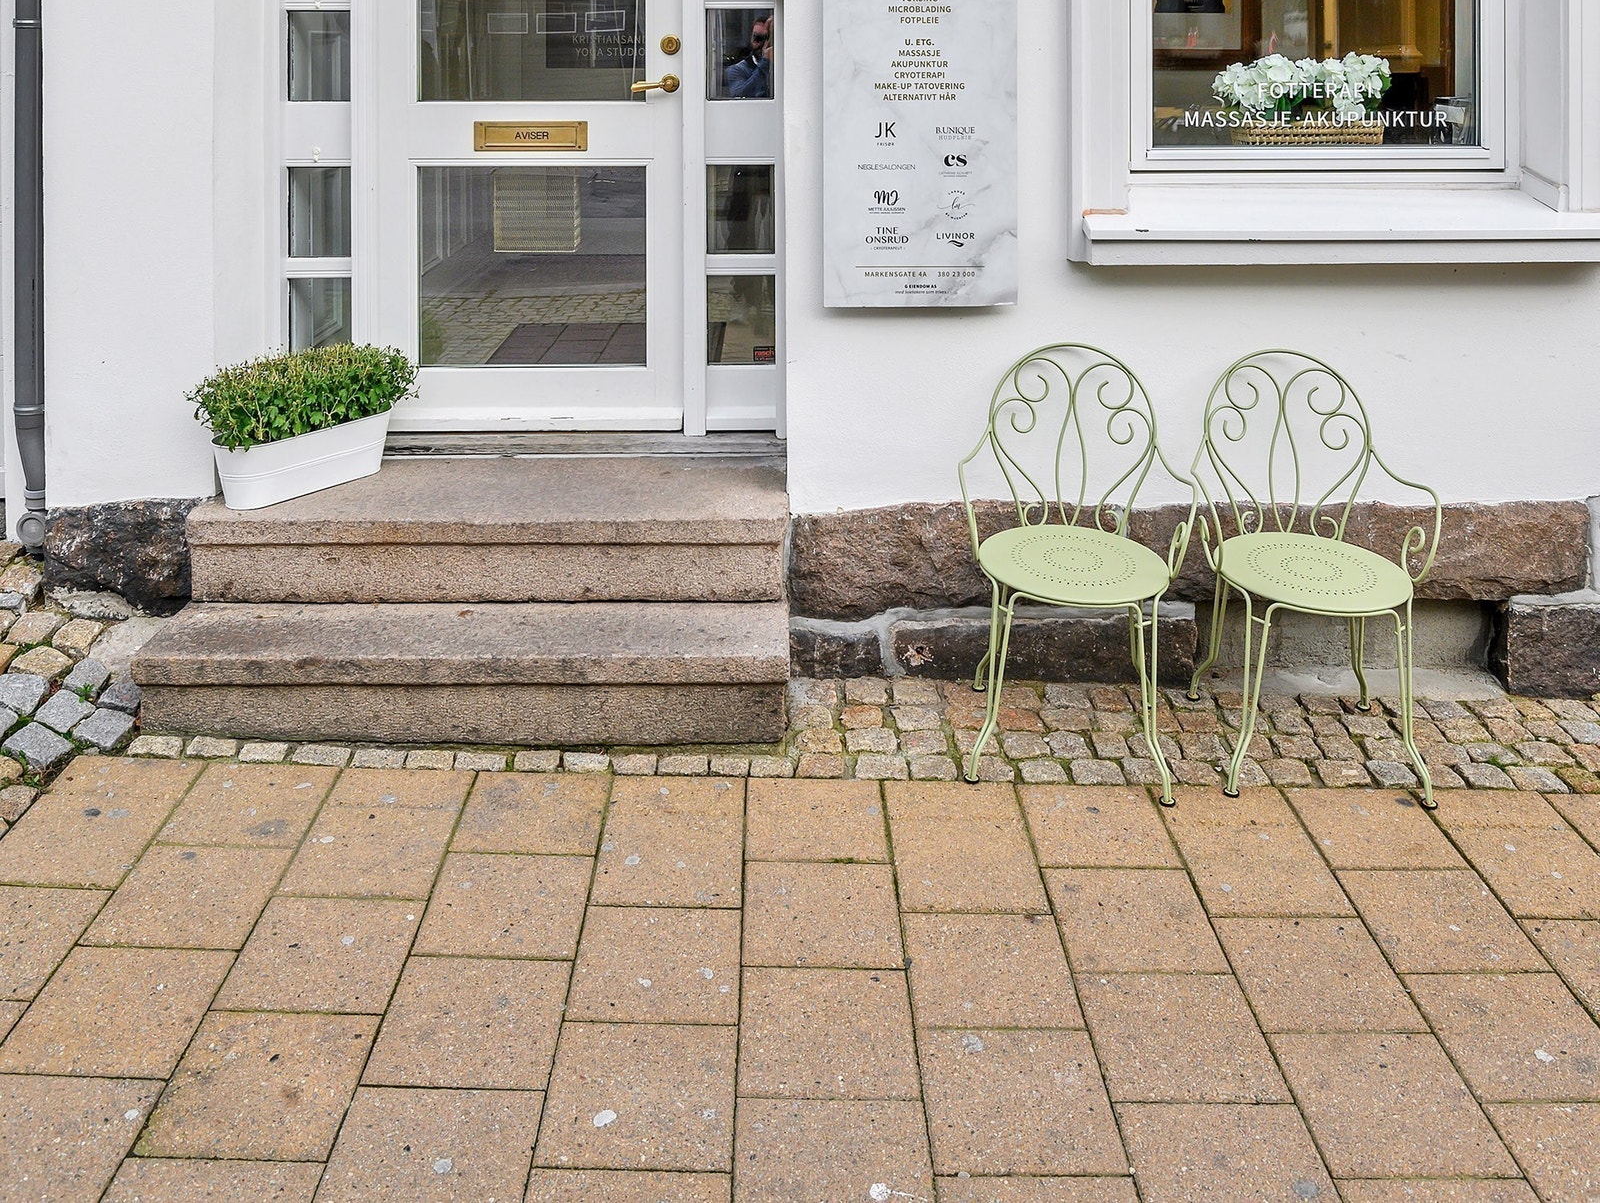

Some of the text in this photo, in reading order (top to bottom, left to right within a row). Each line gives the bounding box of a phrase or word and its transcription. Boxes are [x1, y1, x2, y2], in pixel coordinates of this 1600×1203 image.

[1257, 82, 1373, 98] FOTTERAPI
[939, 92, 957, 101] HÅR
[874, 122, 896, 138] JK
[514, 131, 550, 140] AVISER
[875, 226, 899, 235] TINE
[865, 235, 909, 244] ONSRUD
[936, 232, 976, 240] LIVINOR
